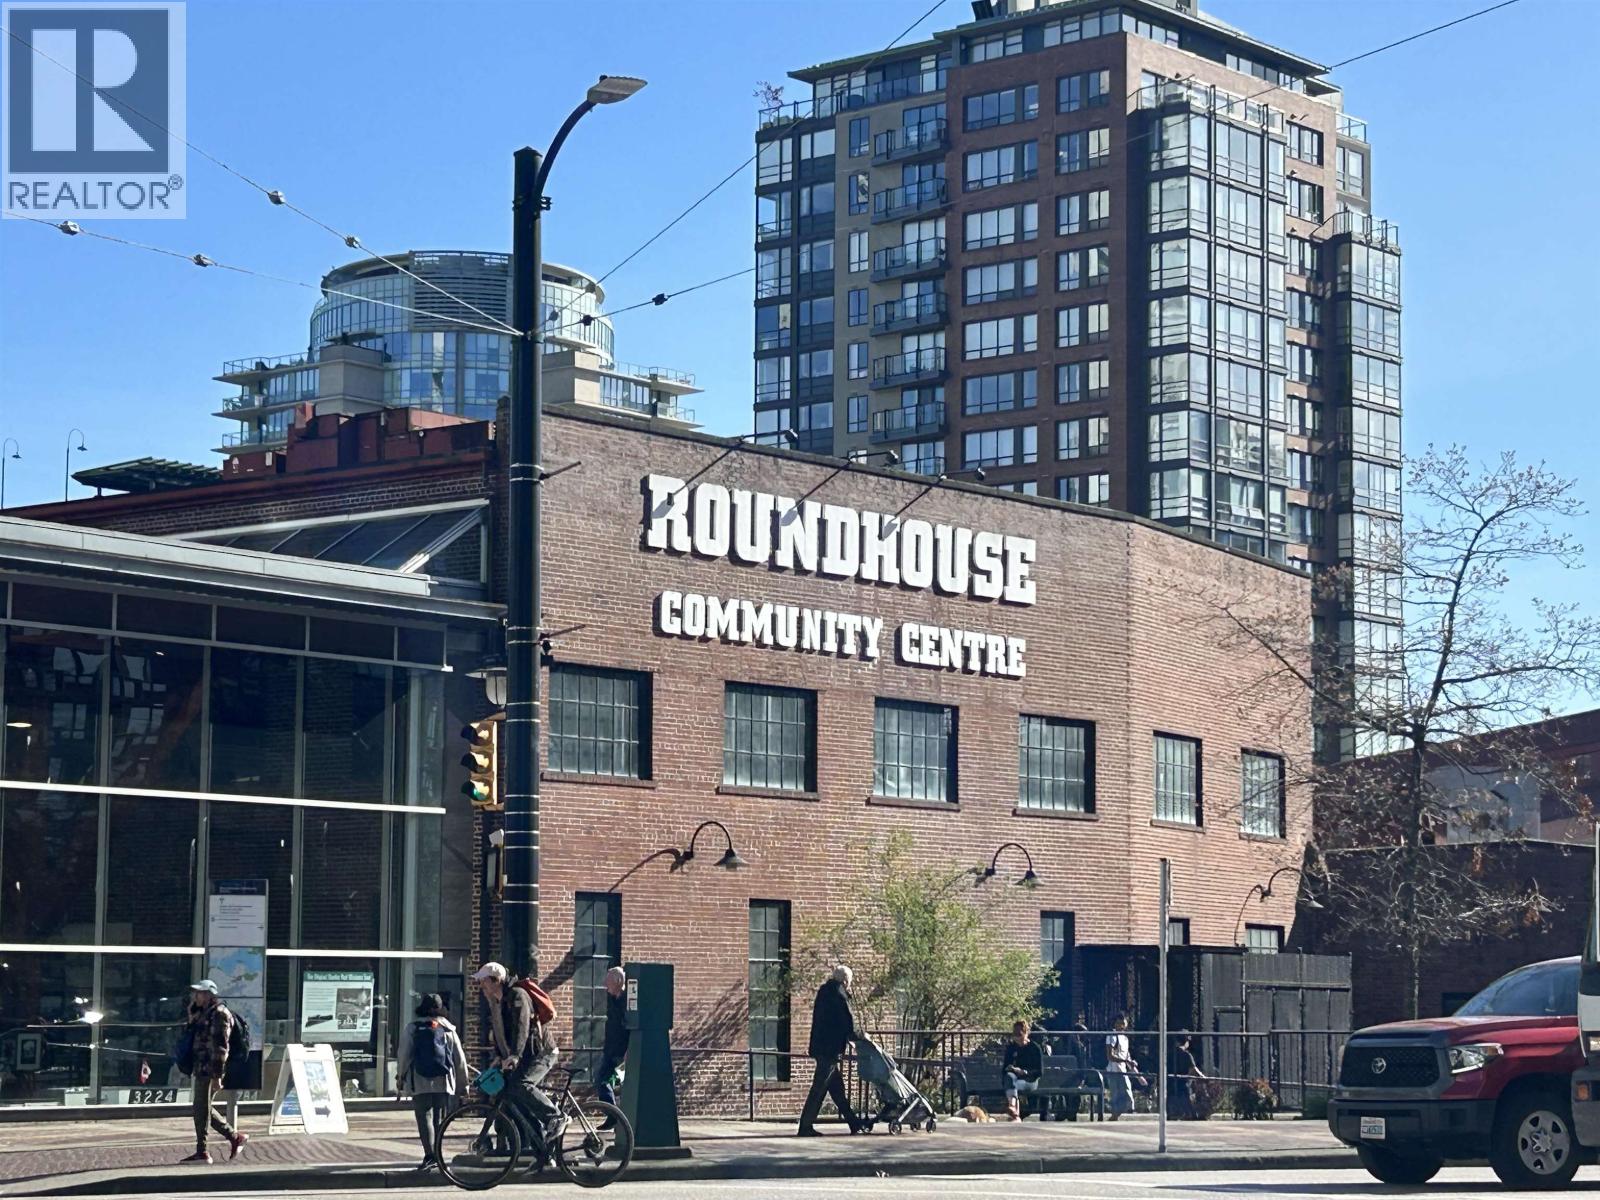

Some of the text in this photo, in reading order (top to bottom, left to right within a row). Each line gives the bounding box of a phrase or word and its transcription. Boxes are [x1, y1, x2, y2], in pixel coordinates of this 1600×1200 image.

[646, 472, 1037, 606] ROUNDHOUSE
[658, 590, 1028, 679] COMMUNITY CENTRE
[133, 1090, 174, 1104] 3224
